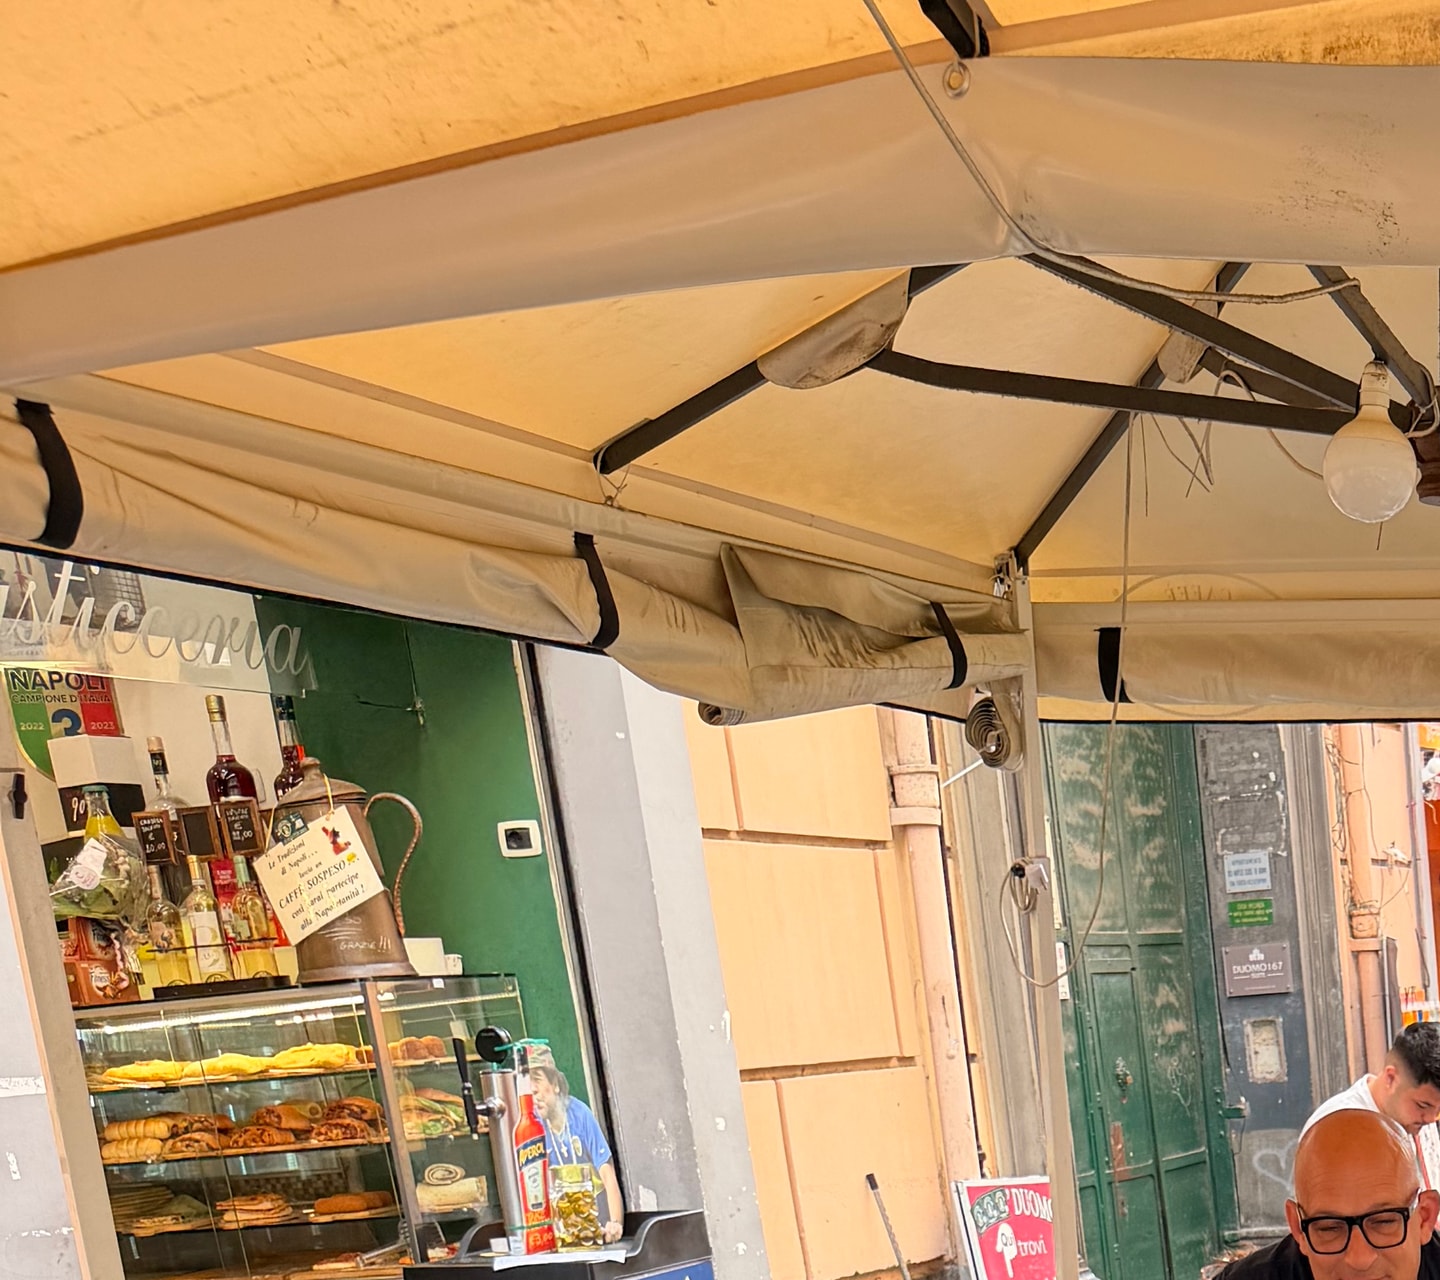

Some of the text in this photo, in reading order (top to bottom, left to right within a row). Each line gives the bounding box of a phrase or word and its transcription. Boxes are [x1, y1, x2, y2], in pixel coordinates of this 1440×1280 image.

[0, 560, 313, 676] sticceria
[8, 669, 107, 691] NAPOLI
[12, 695, 67, 703] CAMPIONE
[20, 722, 45, 731] 2022
[90, 721, 115, 730] 2023
[306, 859, 346, 890] SOSPESO
[518, 1142, 545, 1166] APEROL
[1018, 1235, 1048, 1256] trovi
